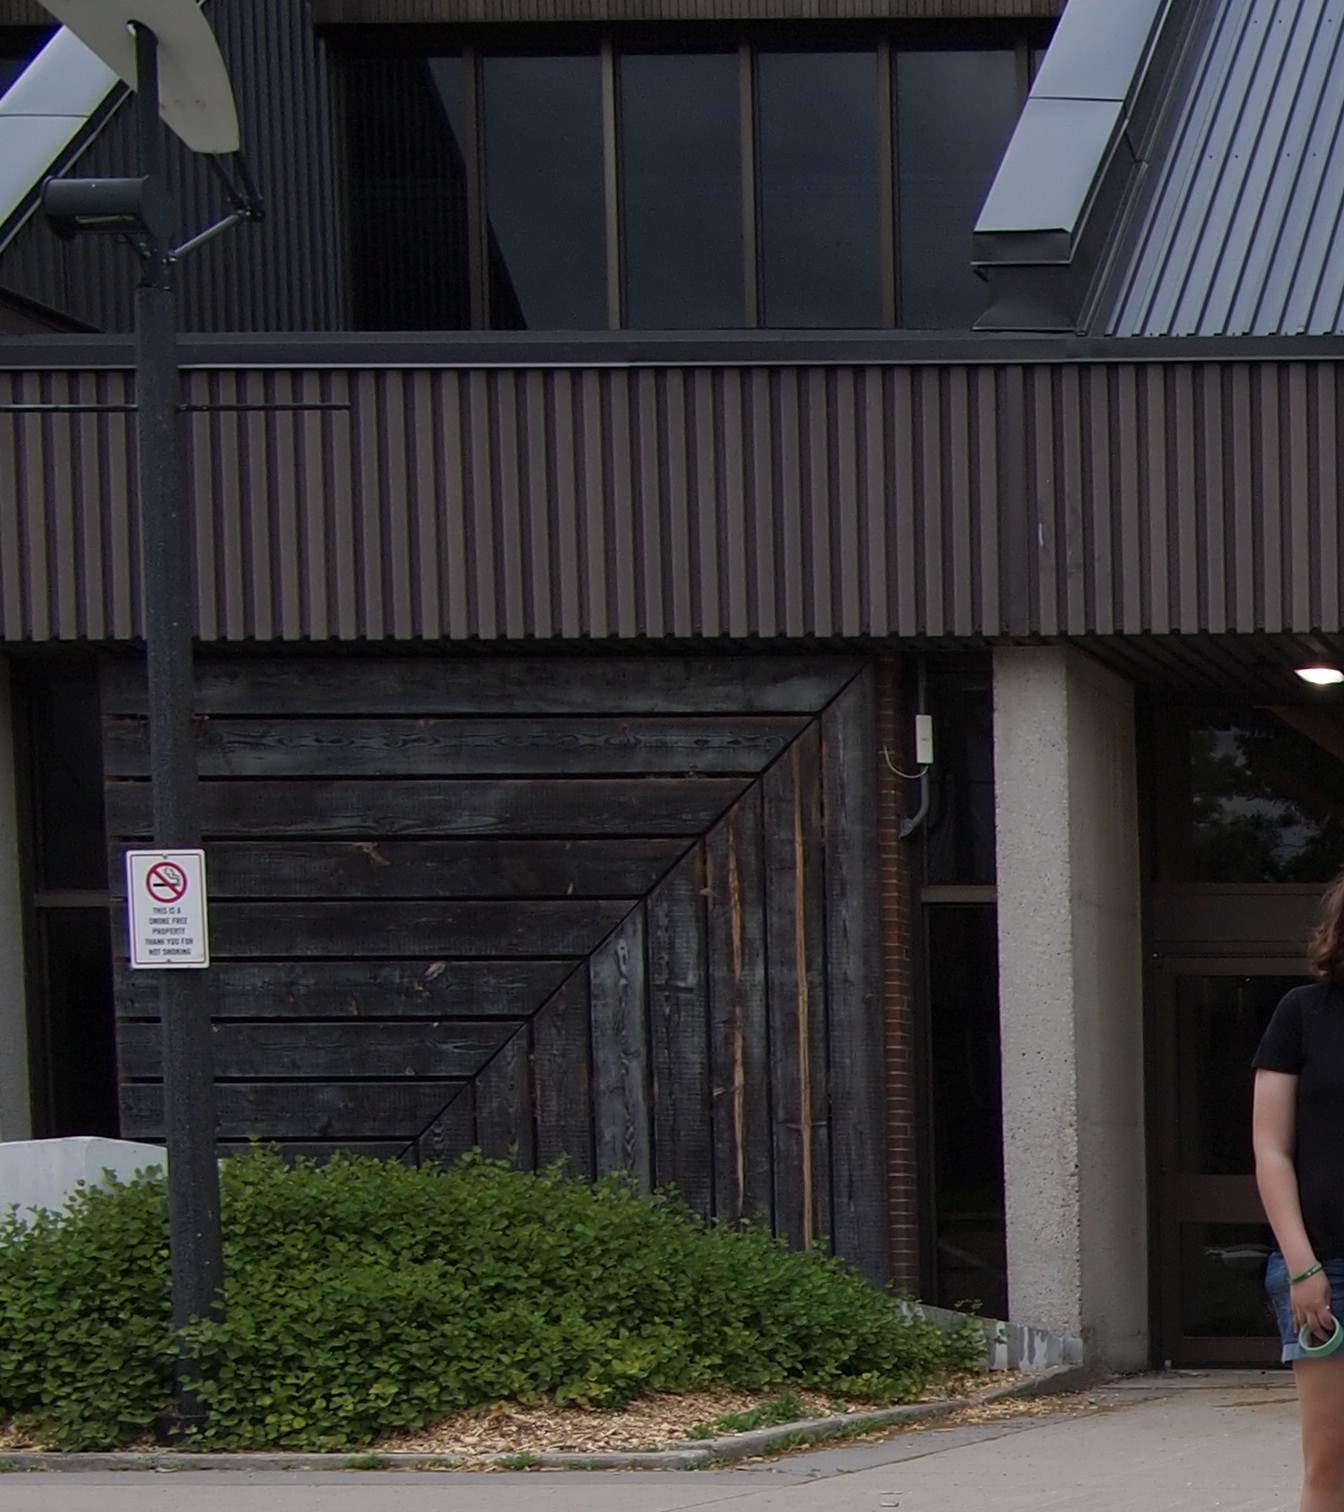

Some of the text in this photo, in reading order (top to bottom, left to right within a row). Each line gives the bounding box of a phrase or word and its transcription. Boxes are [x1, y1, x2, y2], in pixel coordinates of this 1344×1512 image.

[148, 917, 188, 925] SMOKE FREE
[181, 937, 194, 945] FOR
[148, 948, 191, 956] NOT SMOKING
